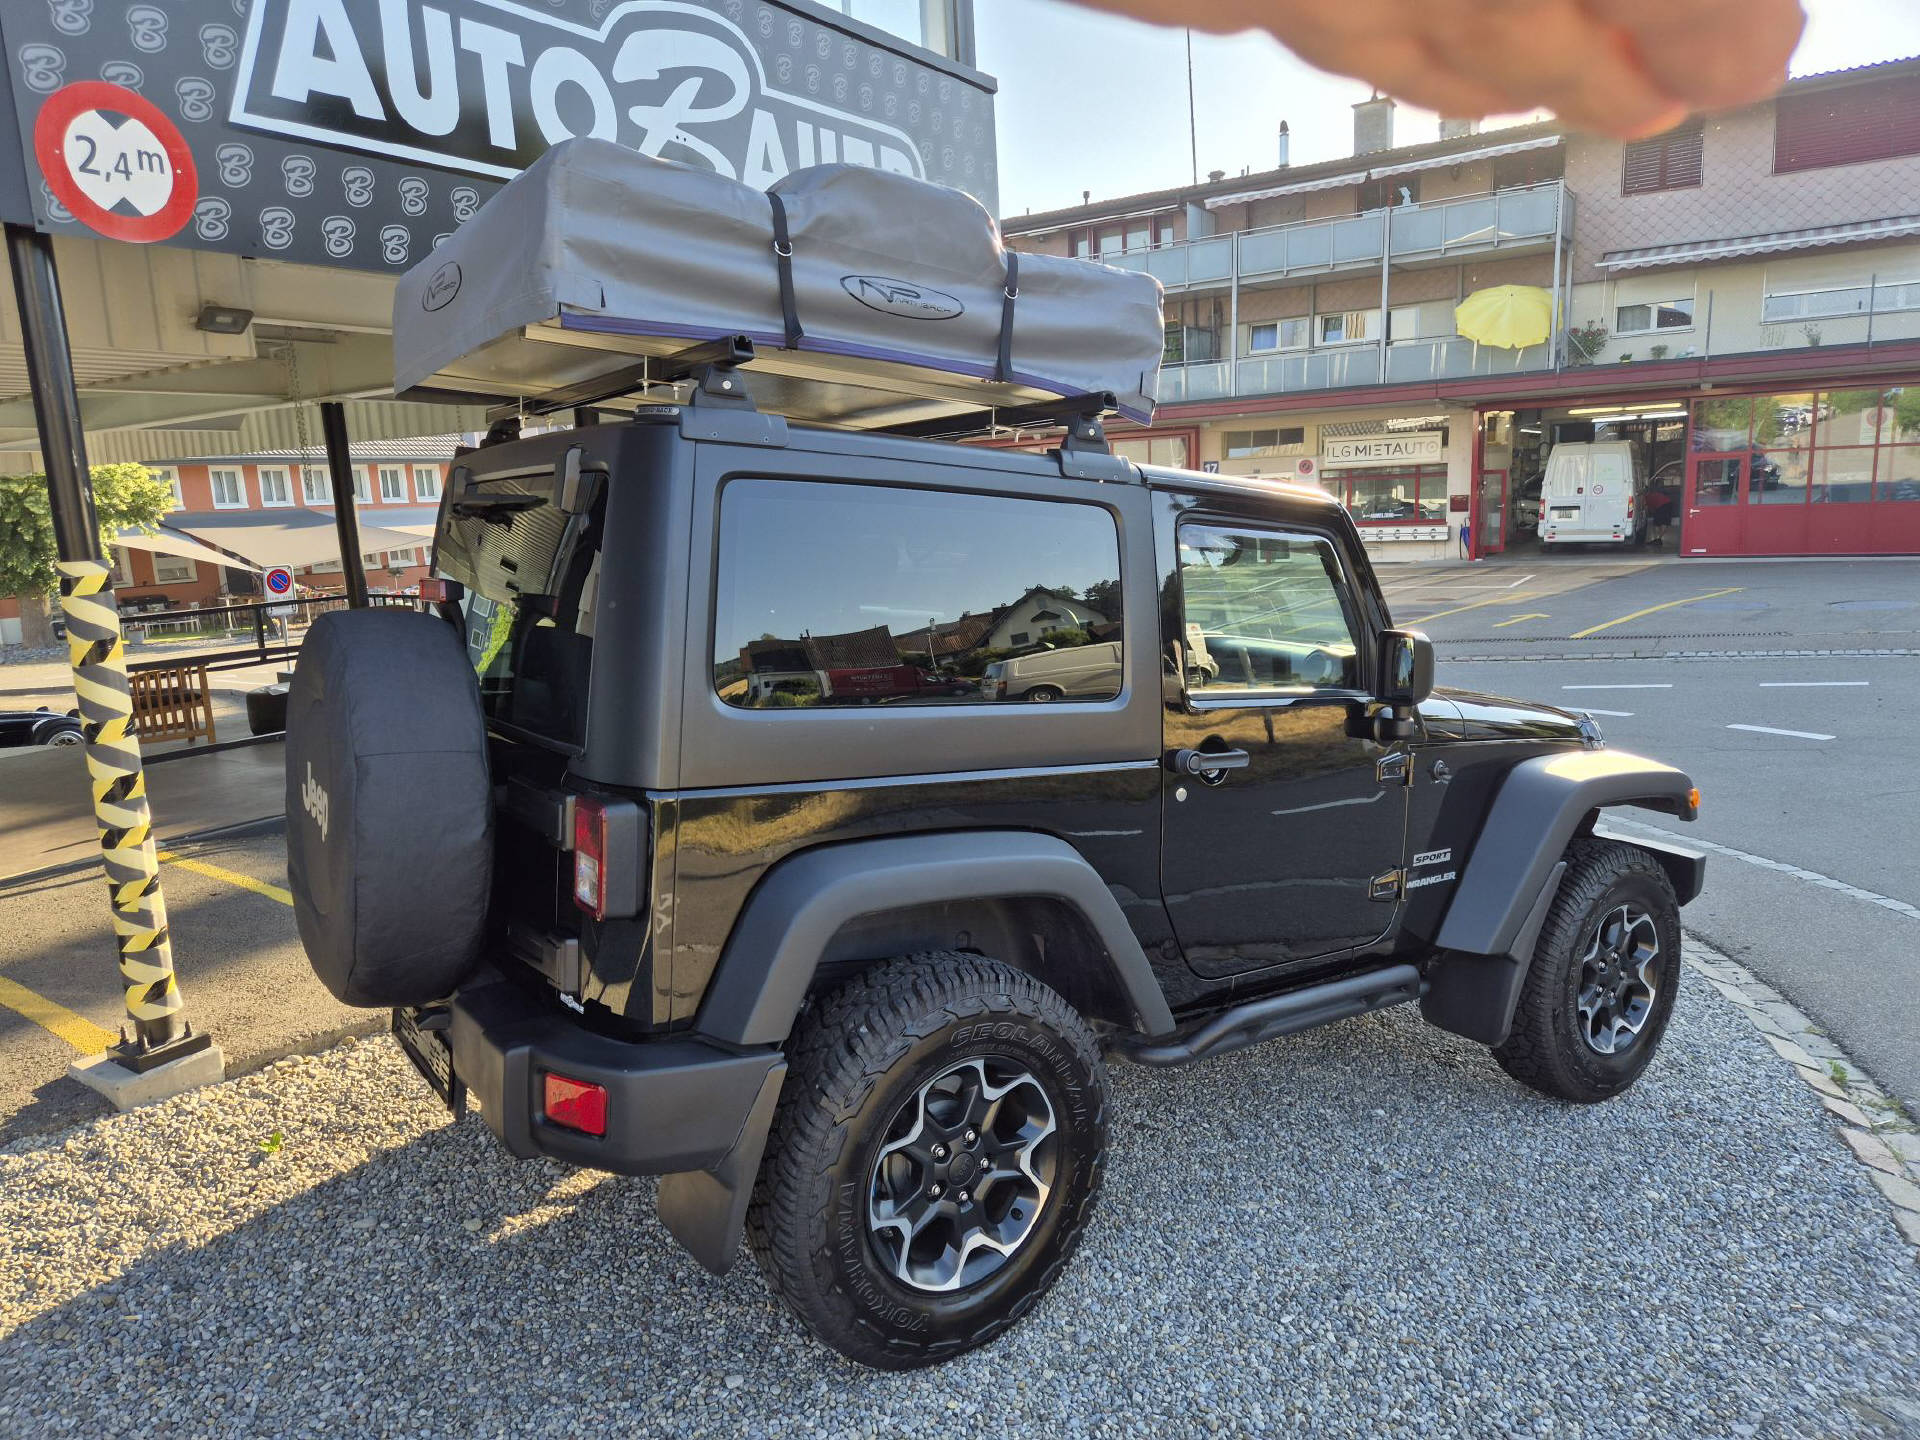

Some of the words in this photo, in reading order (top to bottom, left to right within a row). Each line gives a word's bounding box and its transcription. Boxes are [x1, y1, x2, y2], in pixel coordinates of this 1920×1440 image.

[271, 0, 617, 151] AUTO
[1326, 445, 1351, 458] ILG
[1354, 441, 1439, 457] MIETAUTO
[1204, 463, 1218, 473] 17
[302, 761, 328, 842] Jeep
[1415, 851, 1449, 864] SPORT
[1406, 871, 1456, 888] WRANGLER
